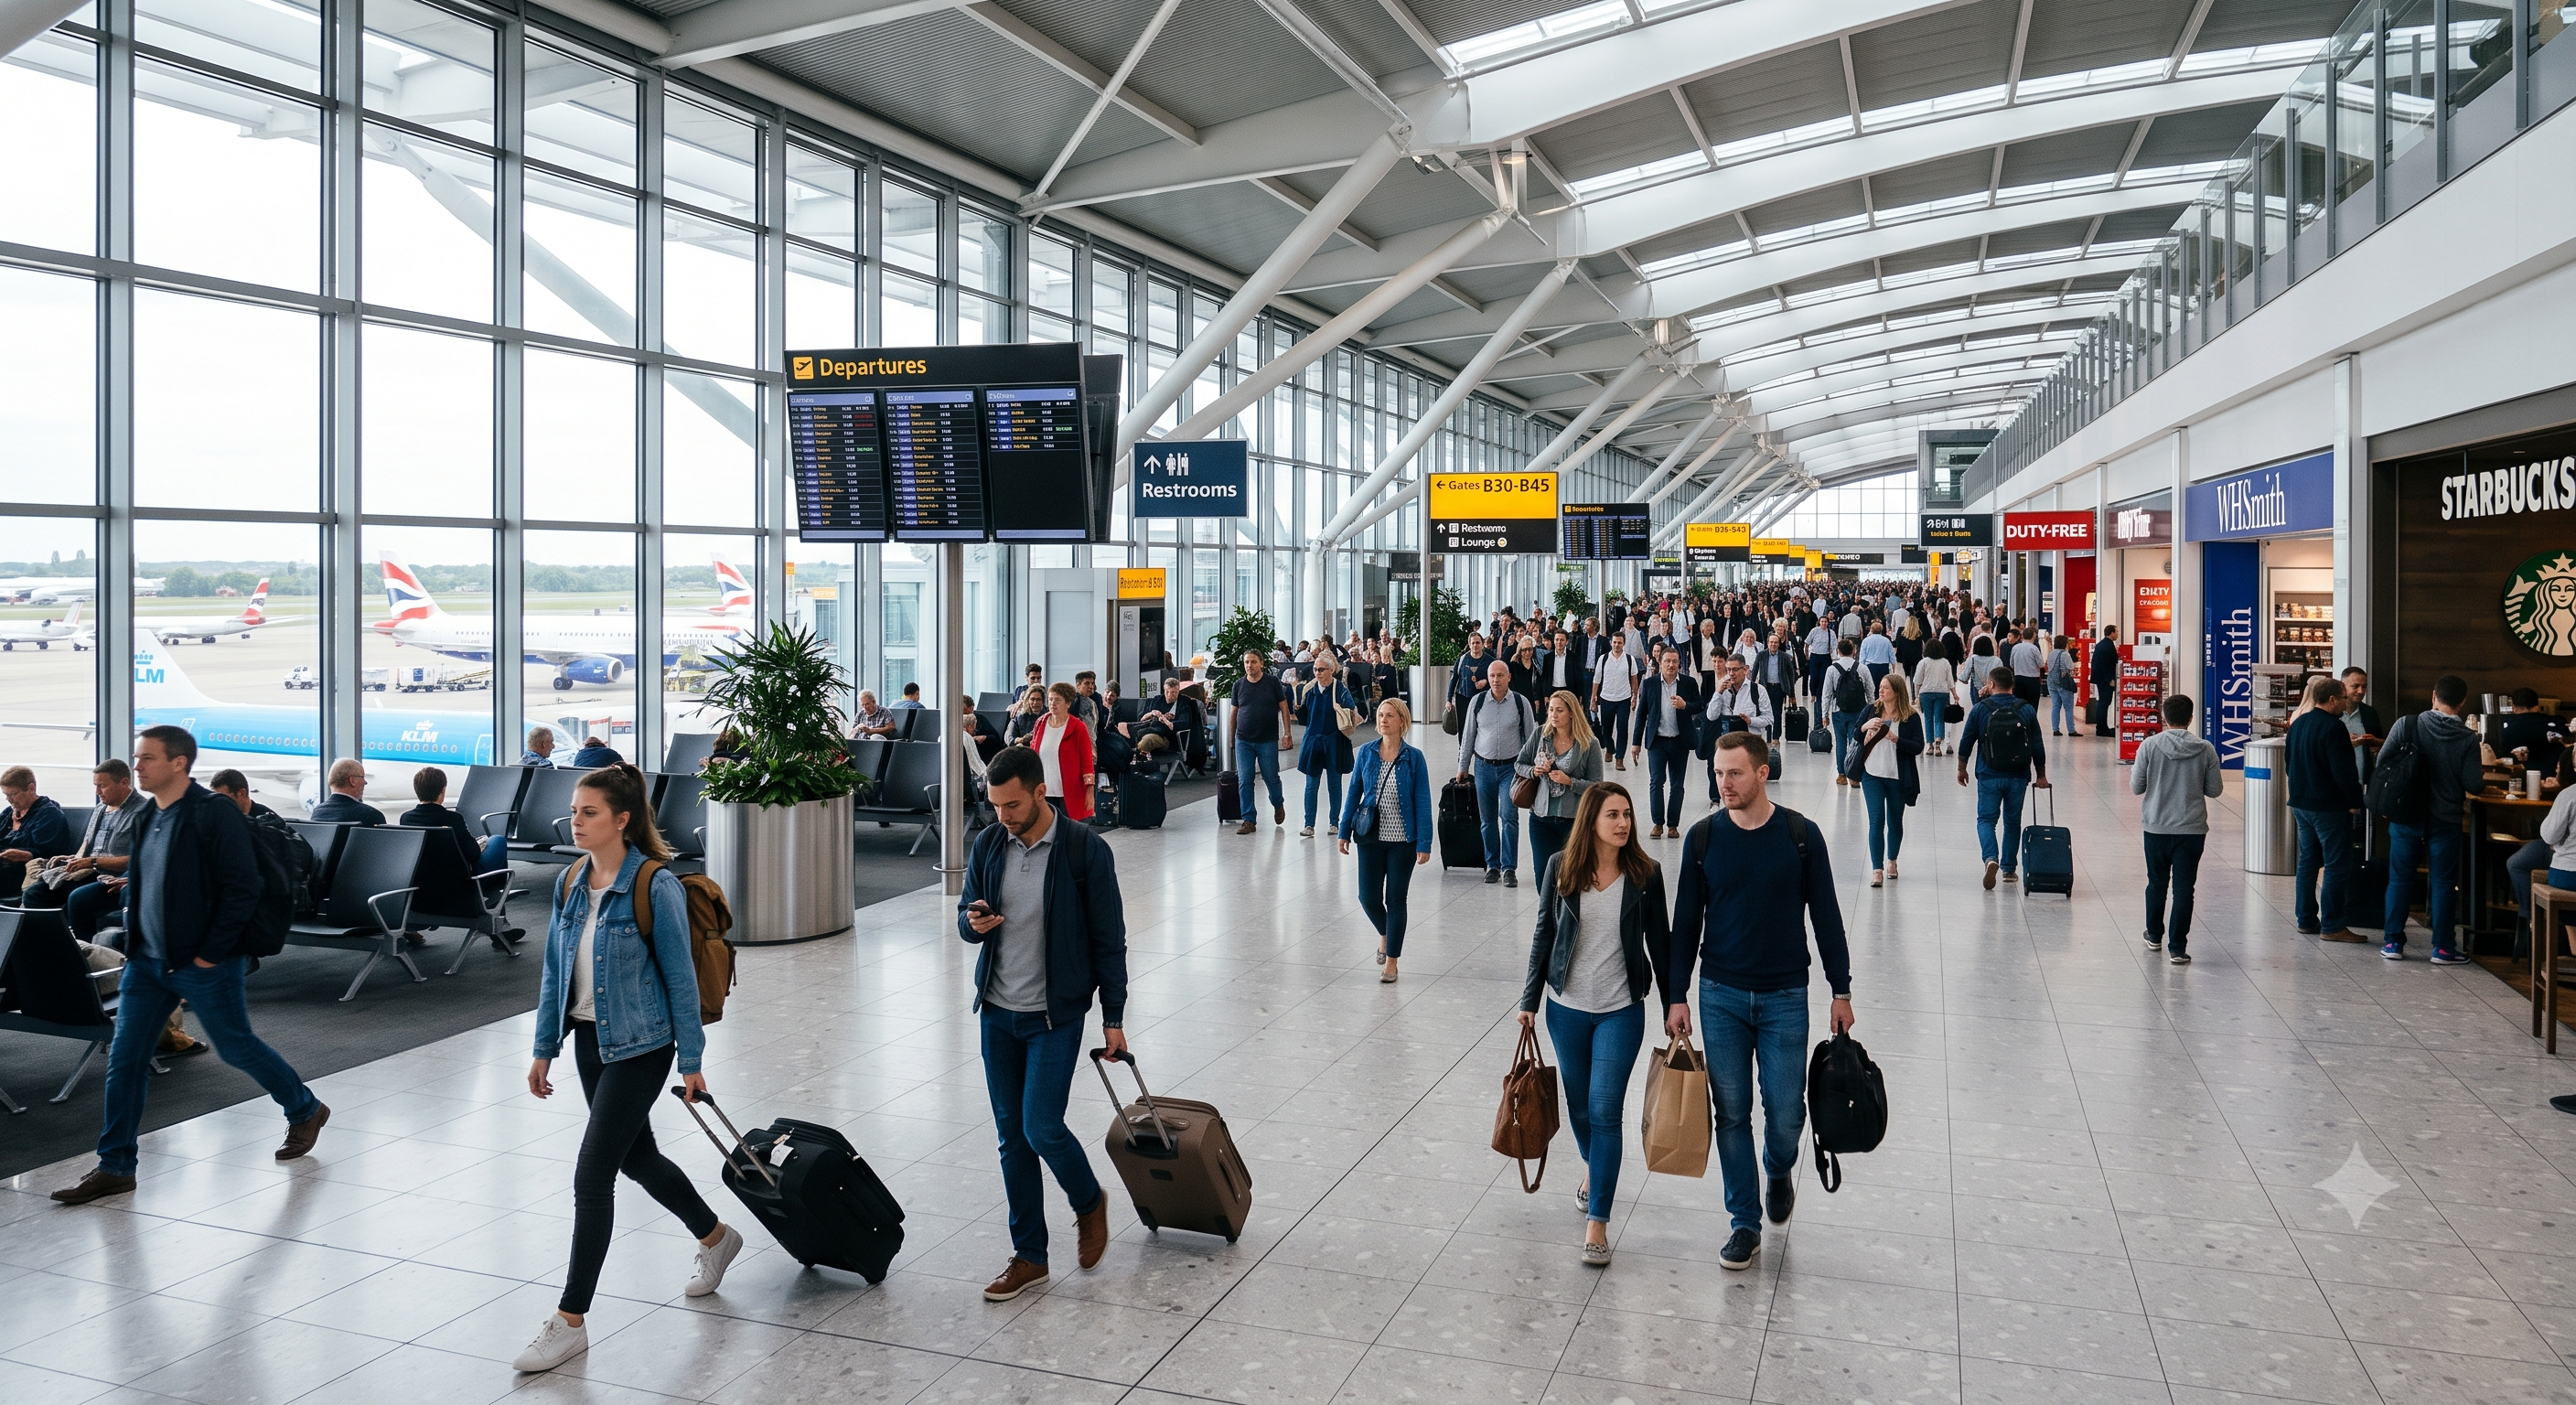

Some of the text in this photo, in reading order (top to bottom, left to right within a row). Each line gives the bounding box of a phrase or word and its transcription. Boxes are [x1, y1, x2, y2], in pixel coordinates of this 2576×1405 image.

[820, 358, 928, 381] Departures
[1143, 482, 1238, 498] Restrooms
[1448, 478, 1550, 493] Gates B30-B45
[2441, 456, 2576, 520] STARBUCKS
[2216, 471, 2286, 533] WHSmith
[2006, 523, 2088, 538] DUTY-FREE
[1461, 537, 1496, 549] Lounge
[134, 668, 165, 683] LM
[2221, 606, 2252, 764] WHSmith
[401, 730, 439, 743] KLM
